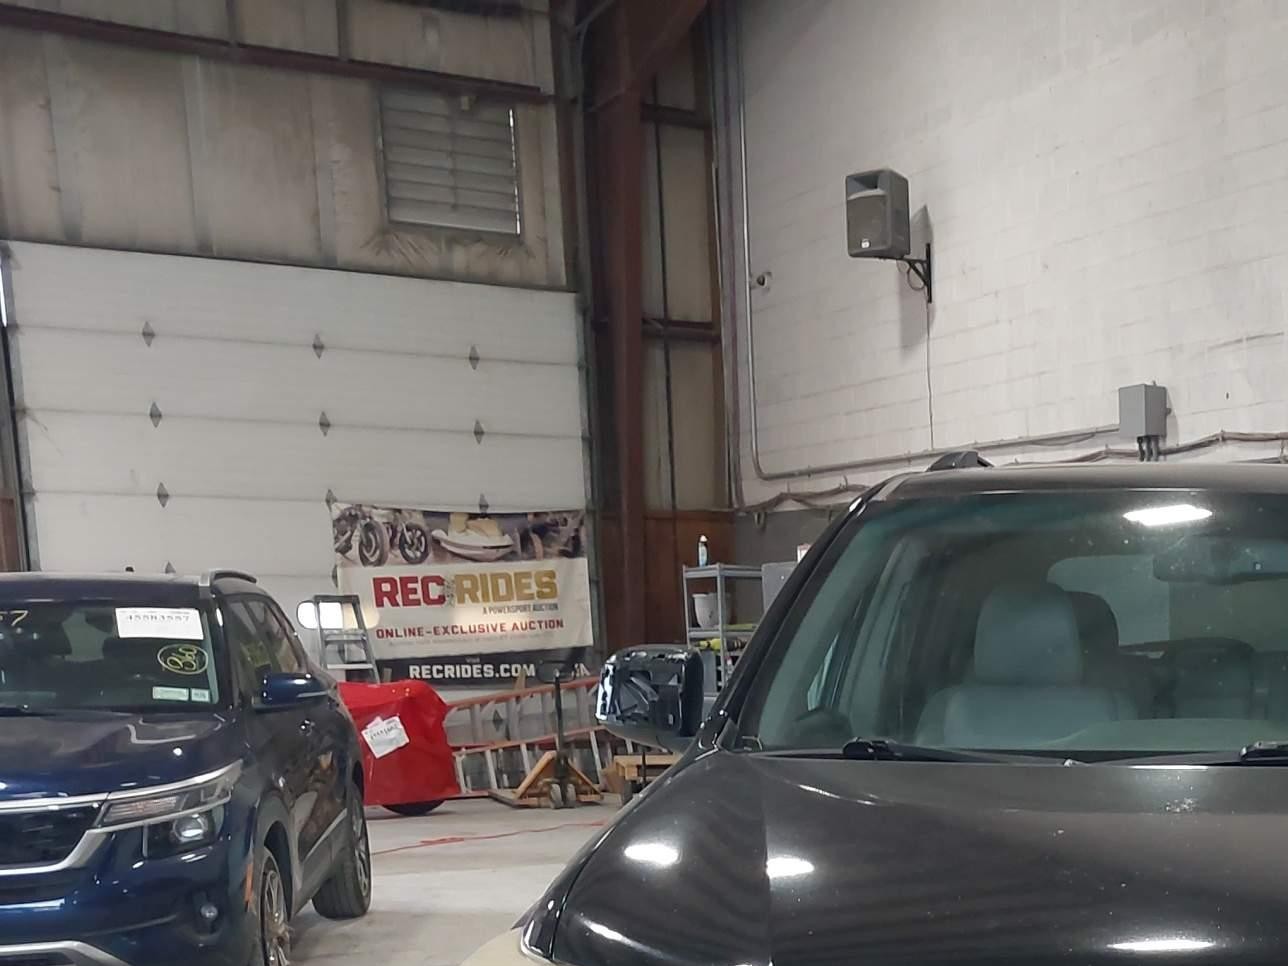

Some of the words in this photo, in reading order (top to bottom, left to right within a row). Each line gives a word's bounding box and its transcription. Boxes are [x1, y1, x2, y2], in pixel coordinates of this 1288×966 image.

[373, 575, 446, 608] REC
[453, 569, 559, 604] RIDES
[532, 602, 559, 612] AUCTION
[376, 621, 507, 639] ONLINE-EXCLUSIVE
[511, 618, 565, 633] AUCTION
[408, 663, 537, 679] RECRIDES.COM
